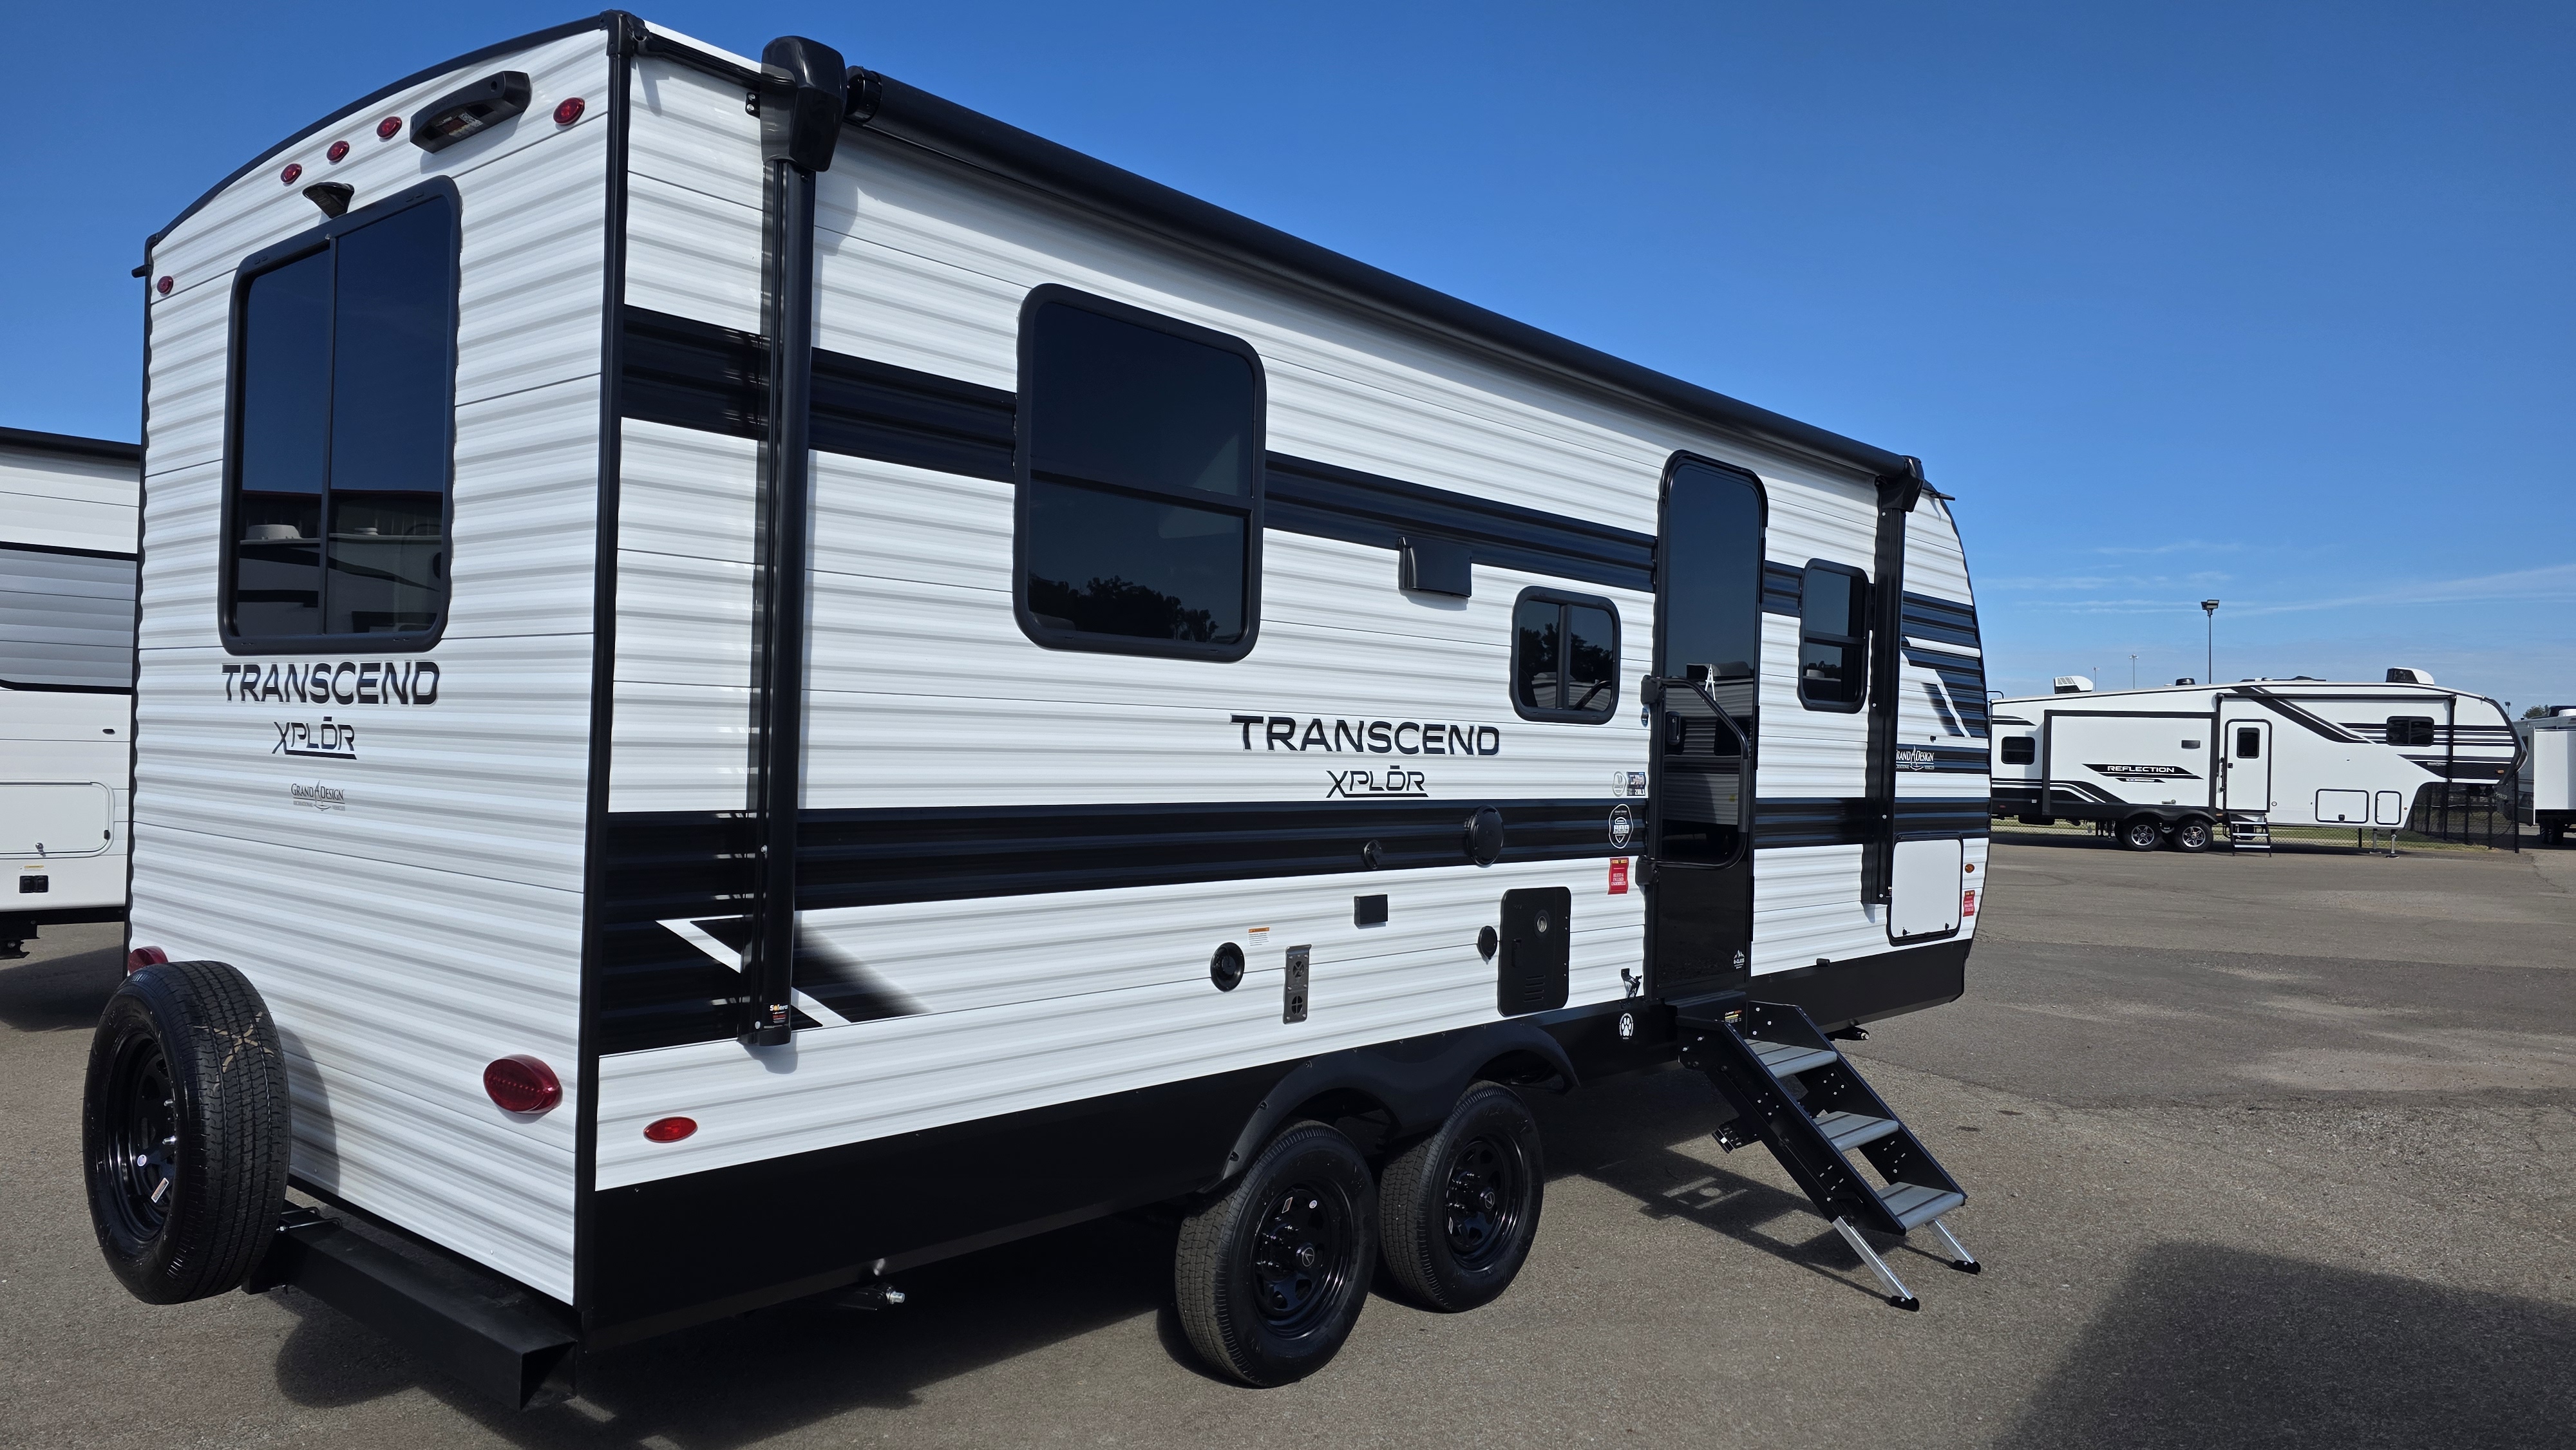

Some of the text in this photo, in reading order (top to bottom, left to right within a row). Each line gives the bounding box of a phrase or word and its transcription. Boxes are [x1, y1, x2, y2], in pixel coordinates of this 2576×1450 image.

[222, 660, 440, 706] TRANSCEND
[1229, 713, 1501, 757] TRANSCEND
[1896, 749, 1935, 762] RAND DESIGN
[290, 783, 345, 801] GRAND DESIGN
